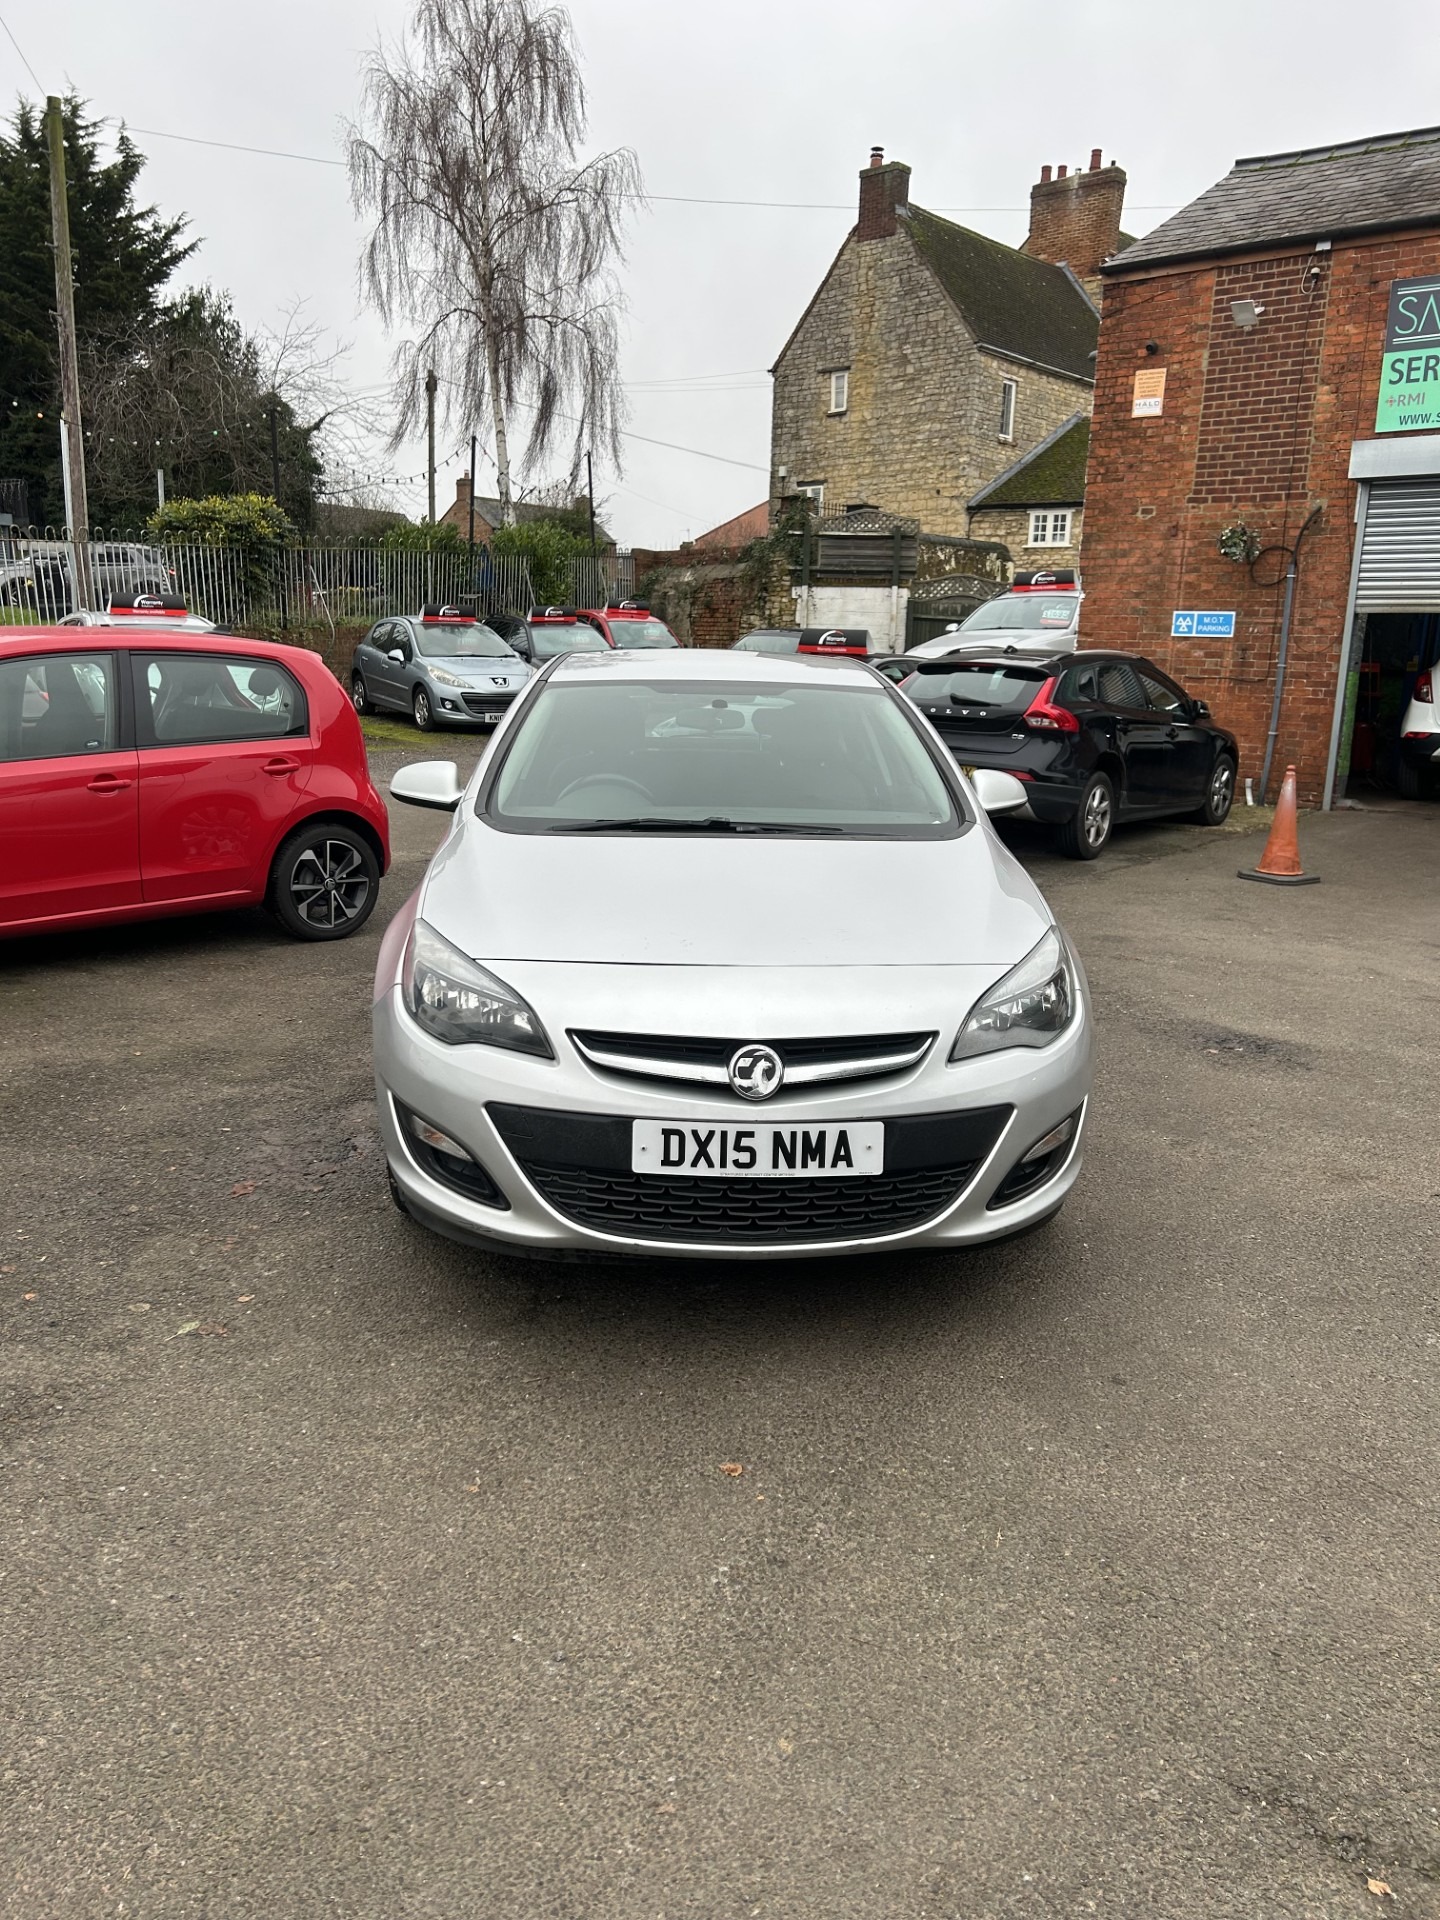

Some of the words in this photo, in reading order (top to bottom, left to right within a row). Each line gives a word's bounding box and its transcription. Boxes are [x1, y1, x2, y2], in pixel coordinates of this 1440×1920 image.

[1397, 392, 1425, 407] RMI
[1203, 616, 1225, 624] M.O.T.
[1197, 624, 1230, 633] PARKING
[660, 1128, 757, 1169] DX15
[772, 1129, 854, 1169] NMA
